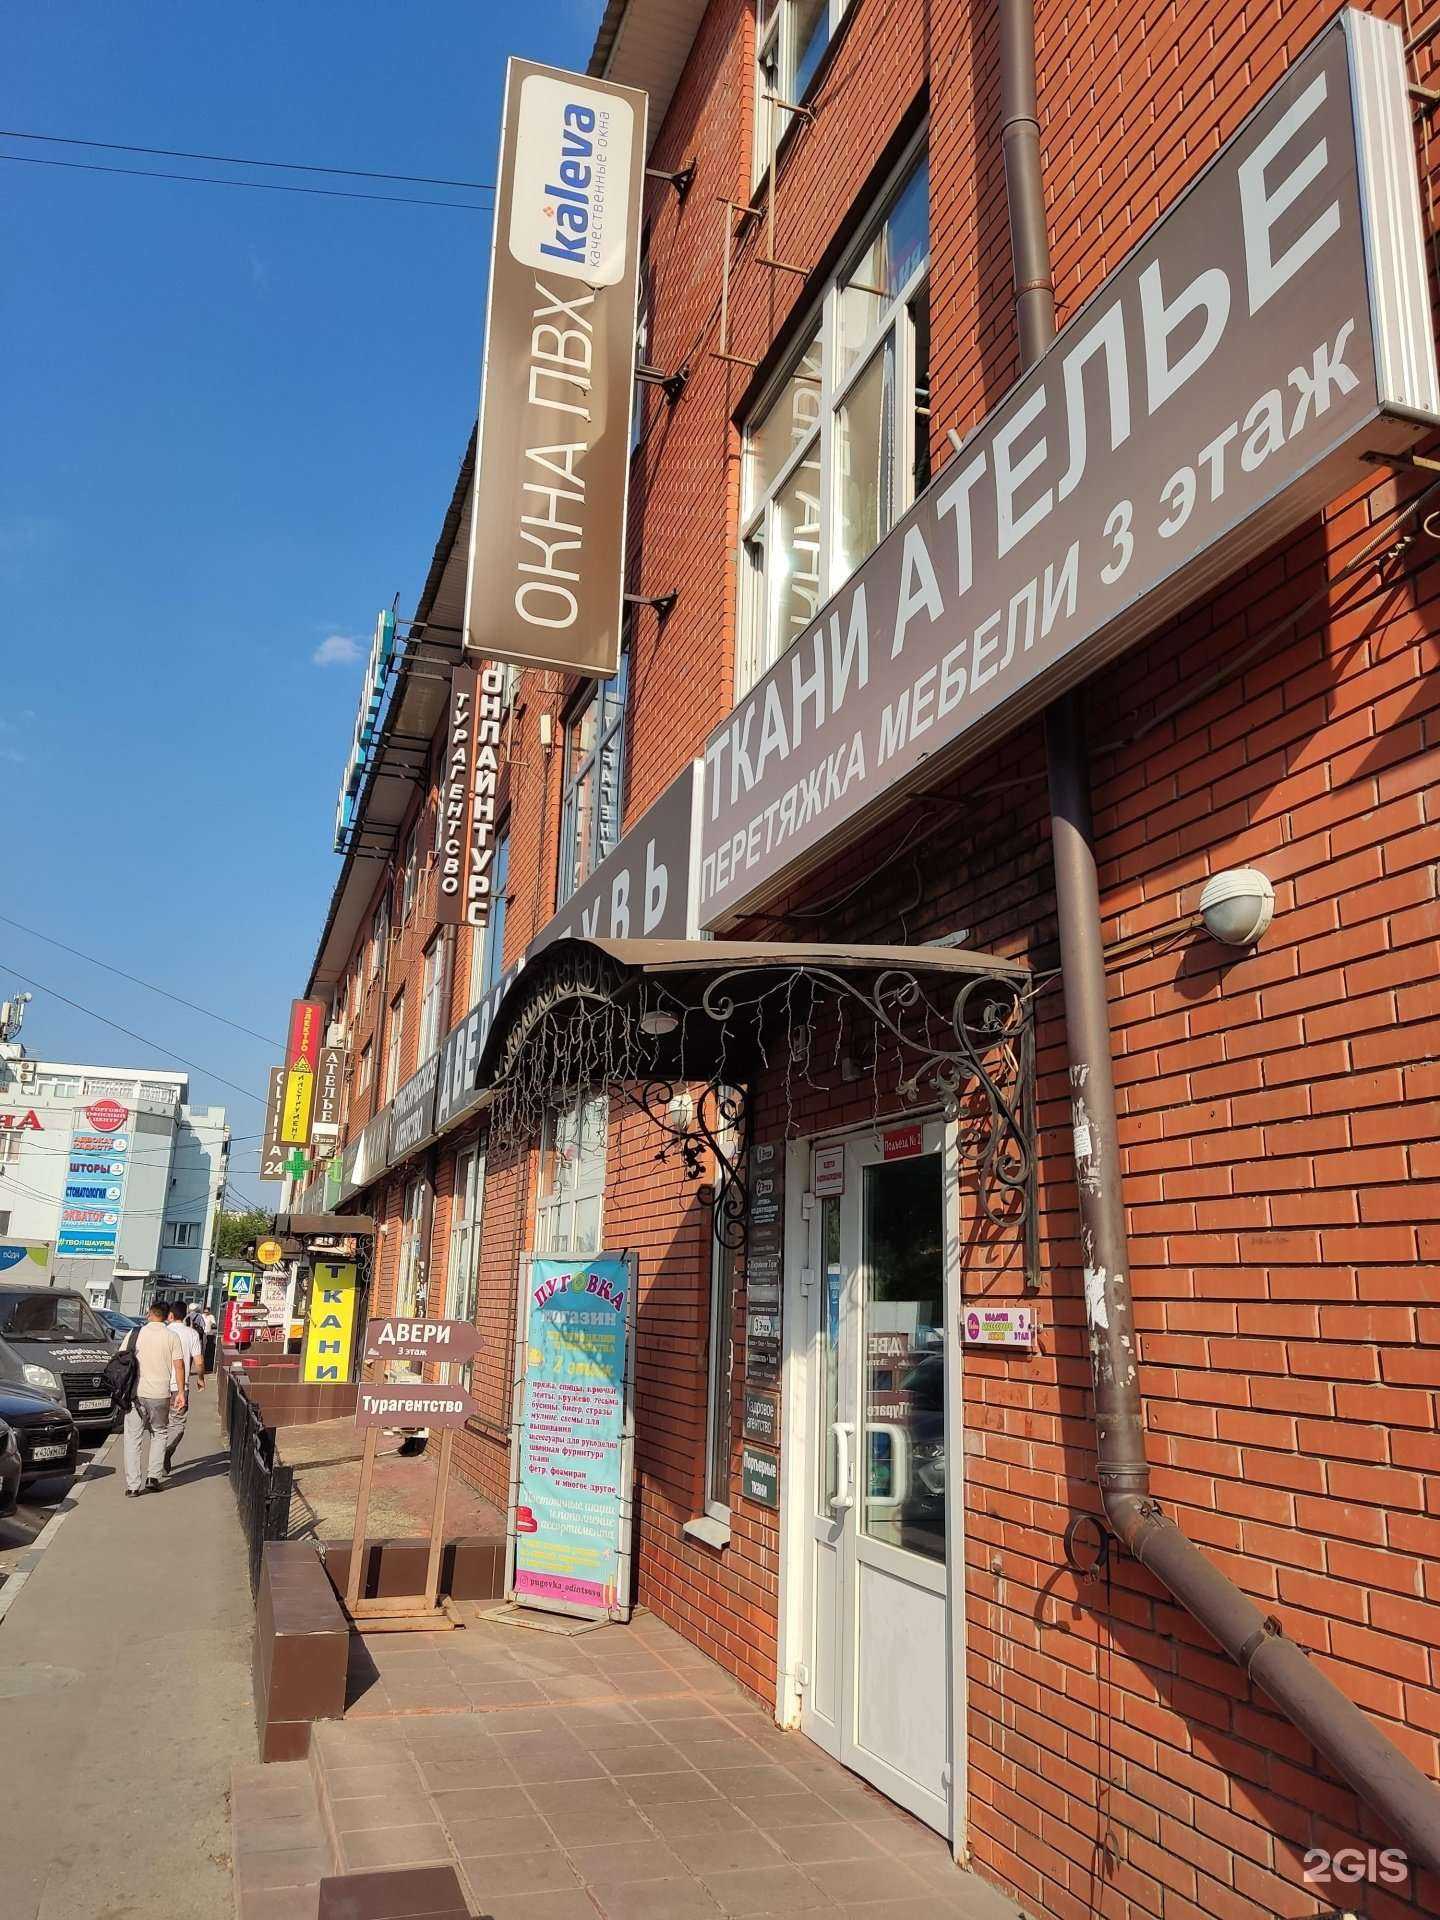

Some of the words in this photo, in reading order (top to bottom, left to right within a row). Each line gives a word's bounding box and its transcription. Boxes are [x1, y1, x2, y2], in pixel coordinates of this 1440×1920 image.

[597, 110, 610, 147] окна
[540, 103, 595, 264] kaleva
[589, 152, 608, 268] качественные
[528, 271, 595, 424] ПВХ
[706, 585, 869, 822] ТКАНИ
[891, 71, 1342, 655] АТЕЛЬЕ
[514, 440, 588, 629] ОКНА
[700, 732, 866, 903] ПЕРЕТЯЖКА
[877, 541, 1079, 760] МЕБЕЛИ
[1101, 500, 1135, 586] 3
[1158, 318, 1360, 540] этаж
[441, 692, 470, 894] ТУРАГЕНТСВО
[467, 669, 503, 926] ОНЛАЙНТУРС
[558, 838, 669, 939] УВЬ
[301, 1007, 312, 1051] ЭЛЕКТРО
[321, 1051, 339, 1122] АТЕЛЬЕ
[65, 1186, 107, 1199] СТОМАТОЛОГИЯ
[70, 1163, 111, 1174] ШТОРЫ
[263, 1162, 283, 1174] 24
[316, 1265, 346, 1379] ТКАНИ
[377, 1322, 452, 1346] ДВЕРИ
[397, 1346, 403, 1355] 3
[405, 1347, 428, 1357] этаж
[362, 1395, 463, 1415] Турагентство
[746, 1416, 772, 1434] агентство
